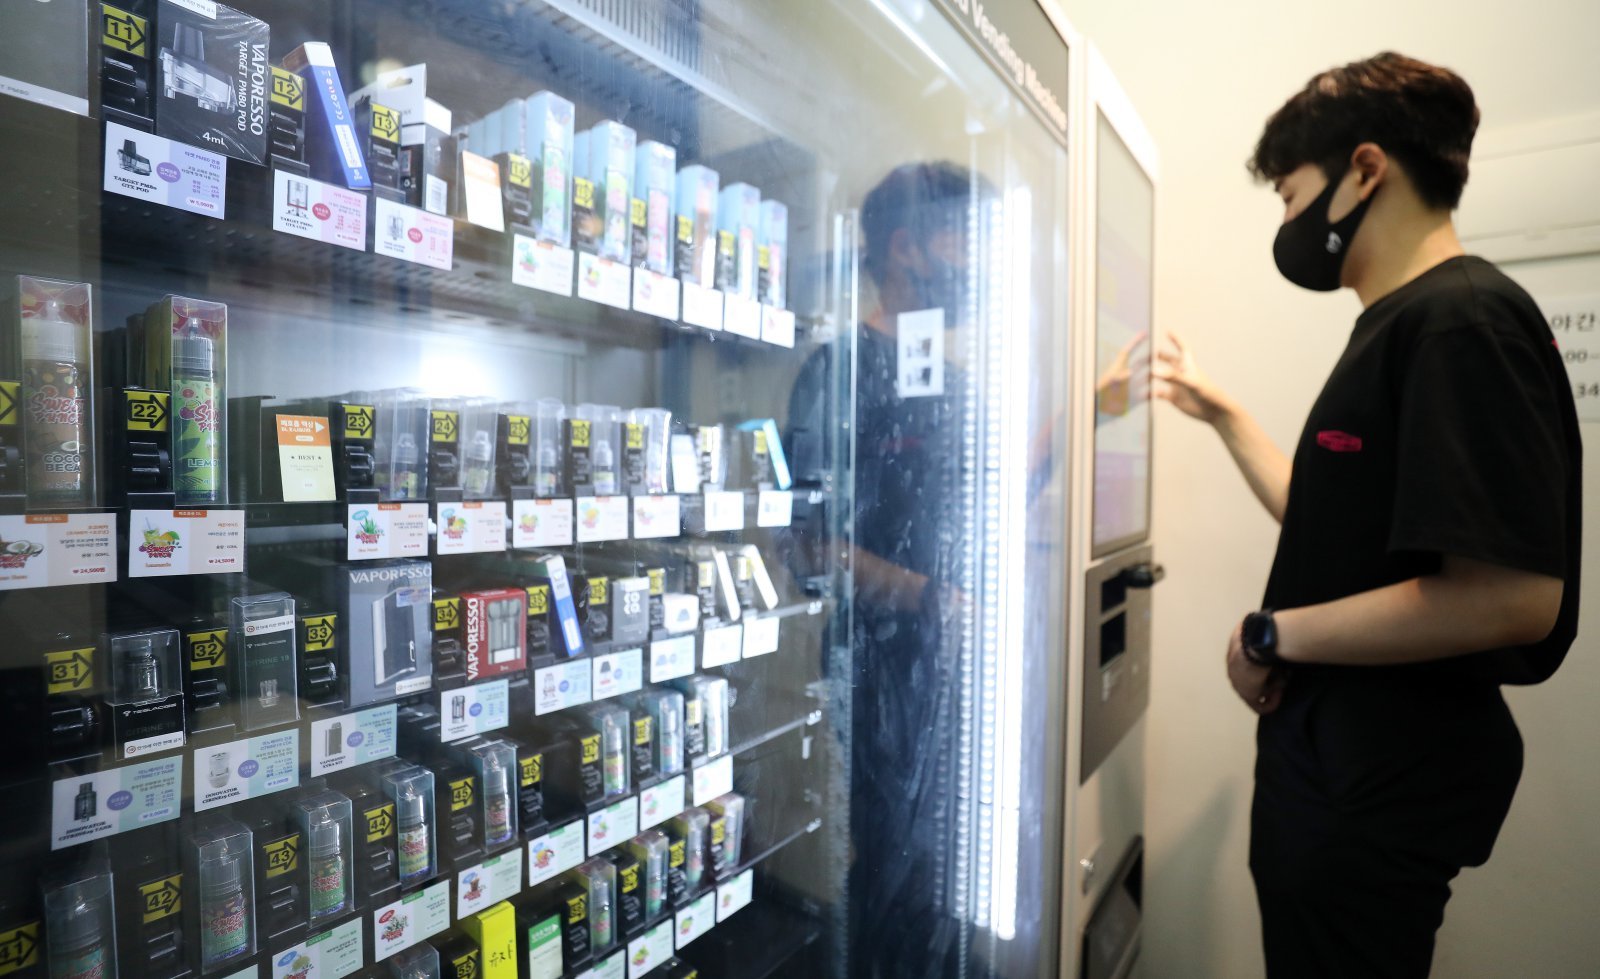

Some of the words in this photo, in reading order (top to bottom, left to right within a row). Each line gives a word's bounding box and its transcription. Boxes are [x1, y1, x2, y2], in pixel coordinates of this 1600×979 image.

[109, 21, 133, 41] 11
[239, 40, 248, 78] TARGET
[238, 79, 247, 107] PM80
[250, 43, 266, 136] VAPORESSO
[276, 81, 296, 97] 12
[237, 110, 246, 131] POD
[377, 116, 392, 130] 13
[114, 175, 139, 186] TARGET
[1551, 313, 1595, 333] 야간
[134, 404, 157, 418] 22
[350, 416, 366, 428] 23
[437, 421, 450, 432] 24
[43, 453, 81, 465] COCO
[45, 463, 81, 473] BECA
[350, 566, 432, 584] VAPORESSO
[438, 607, 453, 621] 34
[309, 627, 328, 640] 33
[467, 597, 479, 681] VAPORESSO
[196, 643, 218, 657] 32
[55, 663, 79, 679] 31
[455, 788, 468, 800] 45
[371, 815, 387, 830] 44
[271, 850, 290, 865] 43
[149, 889, 173, 908] 42
[458, 960, 472, 976] 55
